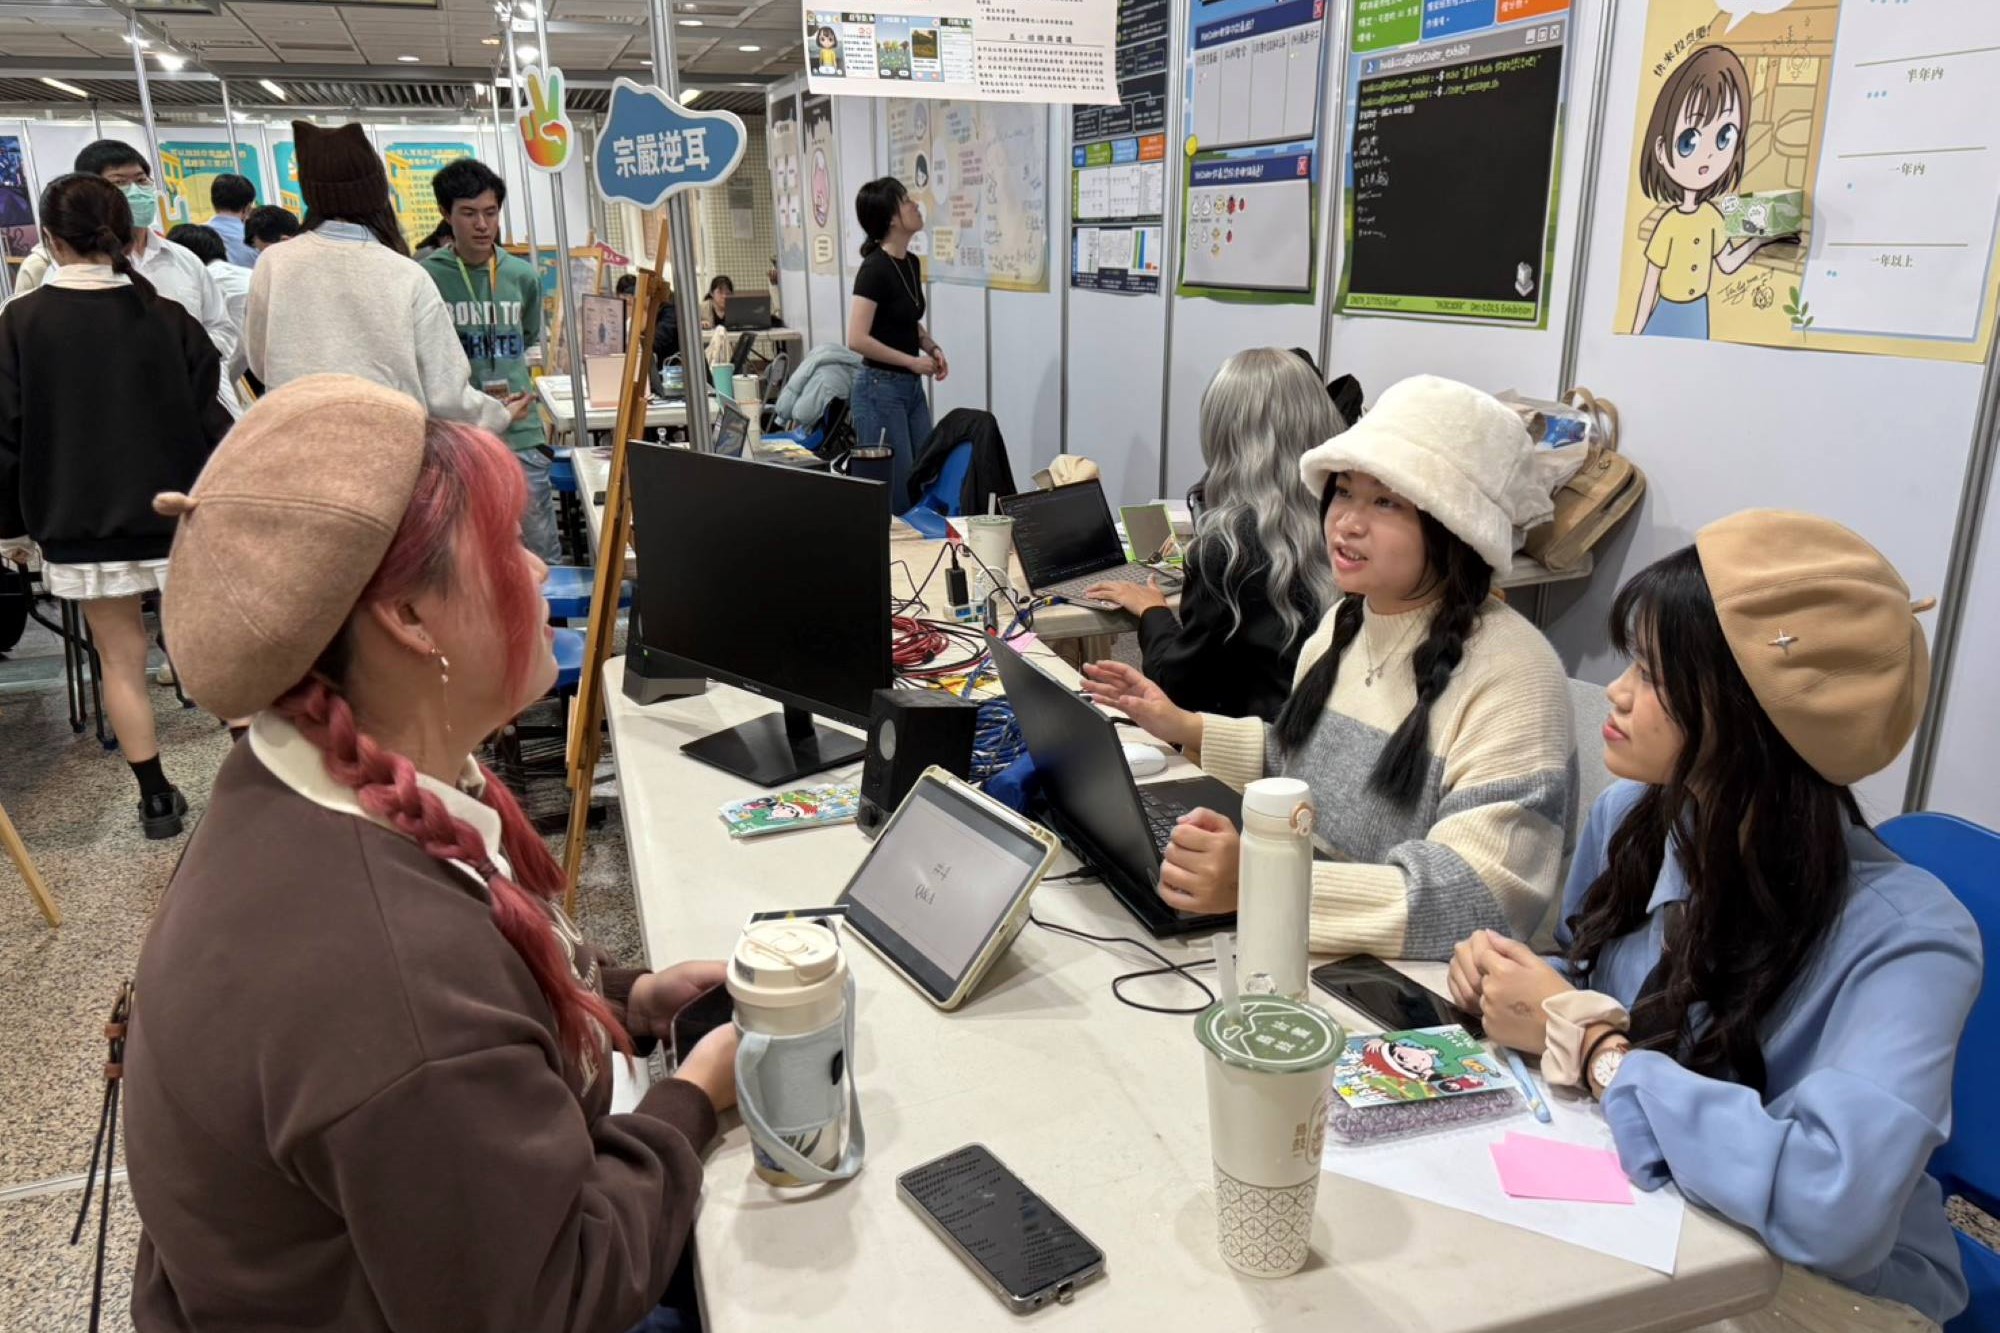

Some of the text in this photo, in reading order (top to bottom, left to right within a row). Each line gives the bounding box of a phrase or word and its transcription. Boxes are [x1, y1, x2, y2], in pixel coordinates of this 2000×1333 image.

[1908, 67, 1944, 83] 半年內
[613, 127, 709, 178] 宗嚴逆耳
[1888, 162, 1925, 176] 一年內
[1871, 254, 1913, 267] 一年以上
